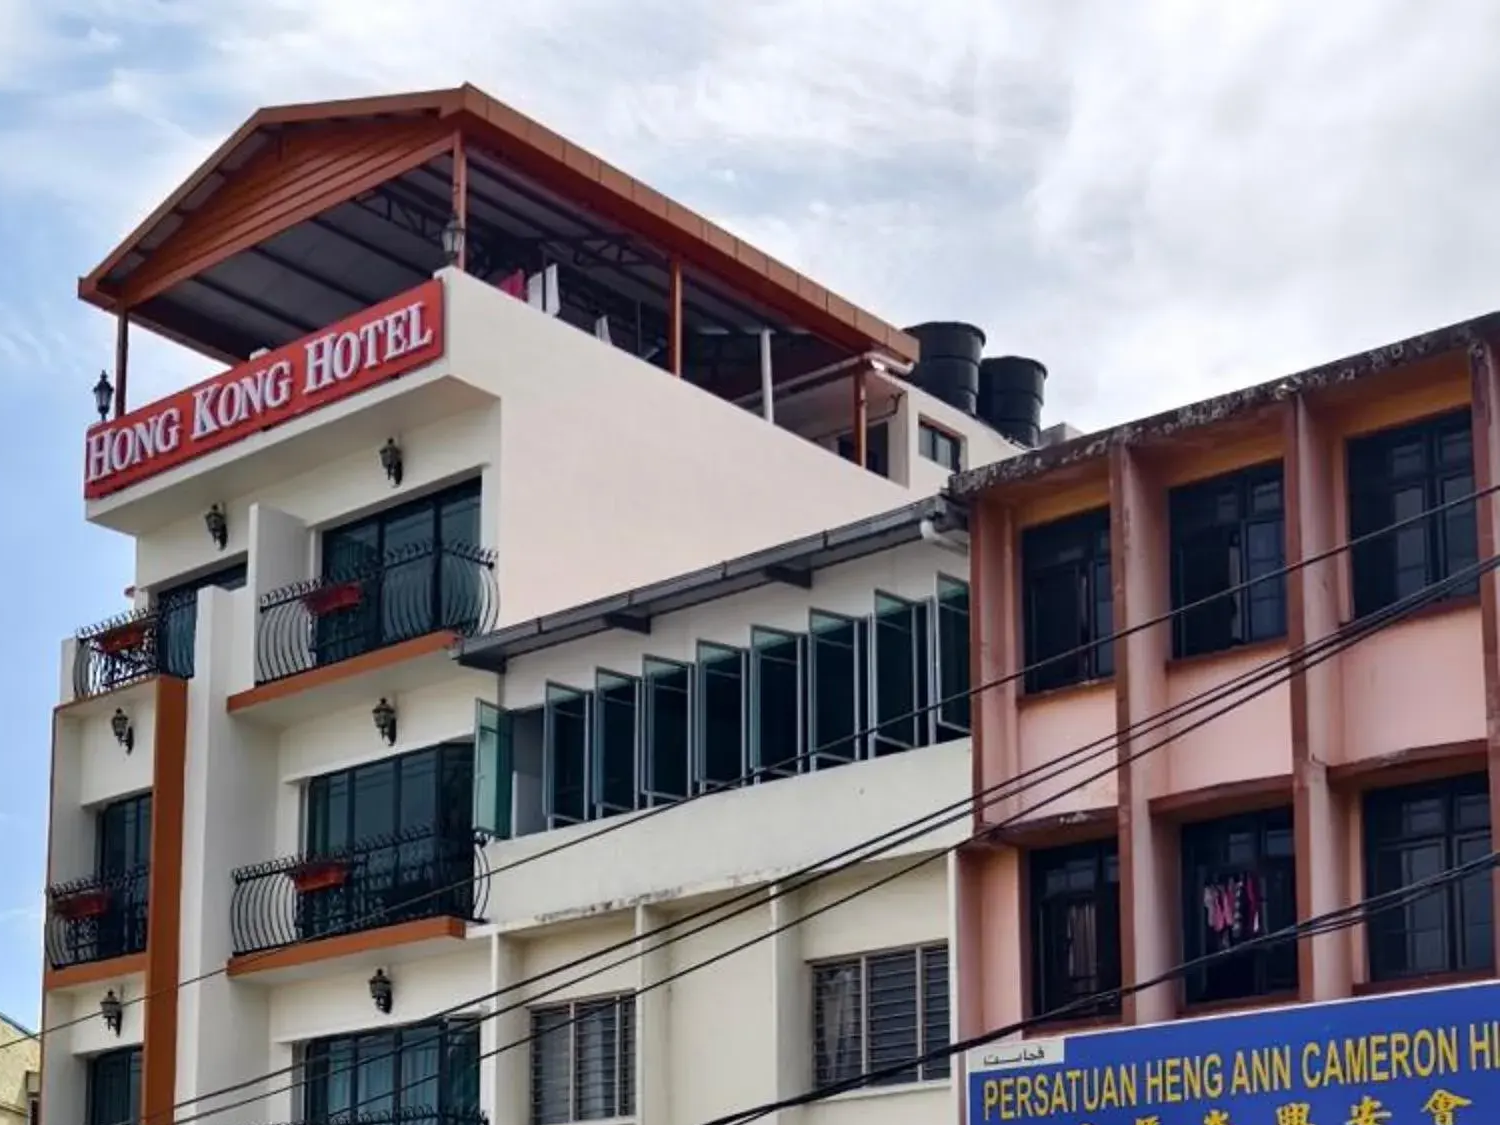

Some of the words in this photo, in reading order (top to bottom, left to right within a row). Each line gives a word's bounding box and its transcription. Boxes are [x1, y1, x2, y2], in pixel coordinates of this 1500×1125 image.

[86, 407, 179, 483] HONG
[191, 359, 293, 441] KONG
[303, 301, 434, 393] HOTEL
[984, 1064, 1137, 1121] PERSATUAN
[1145, 1052, 1222, 1105] HENG
[1231, 1044, 1291, 1095] ANN
[1302, 1027, 1458, 1088] CAMERON
